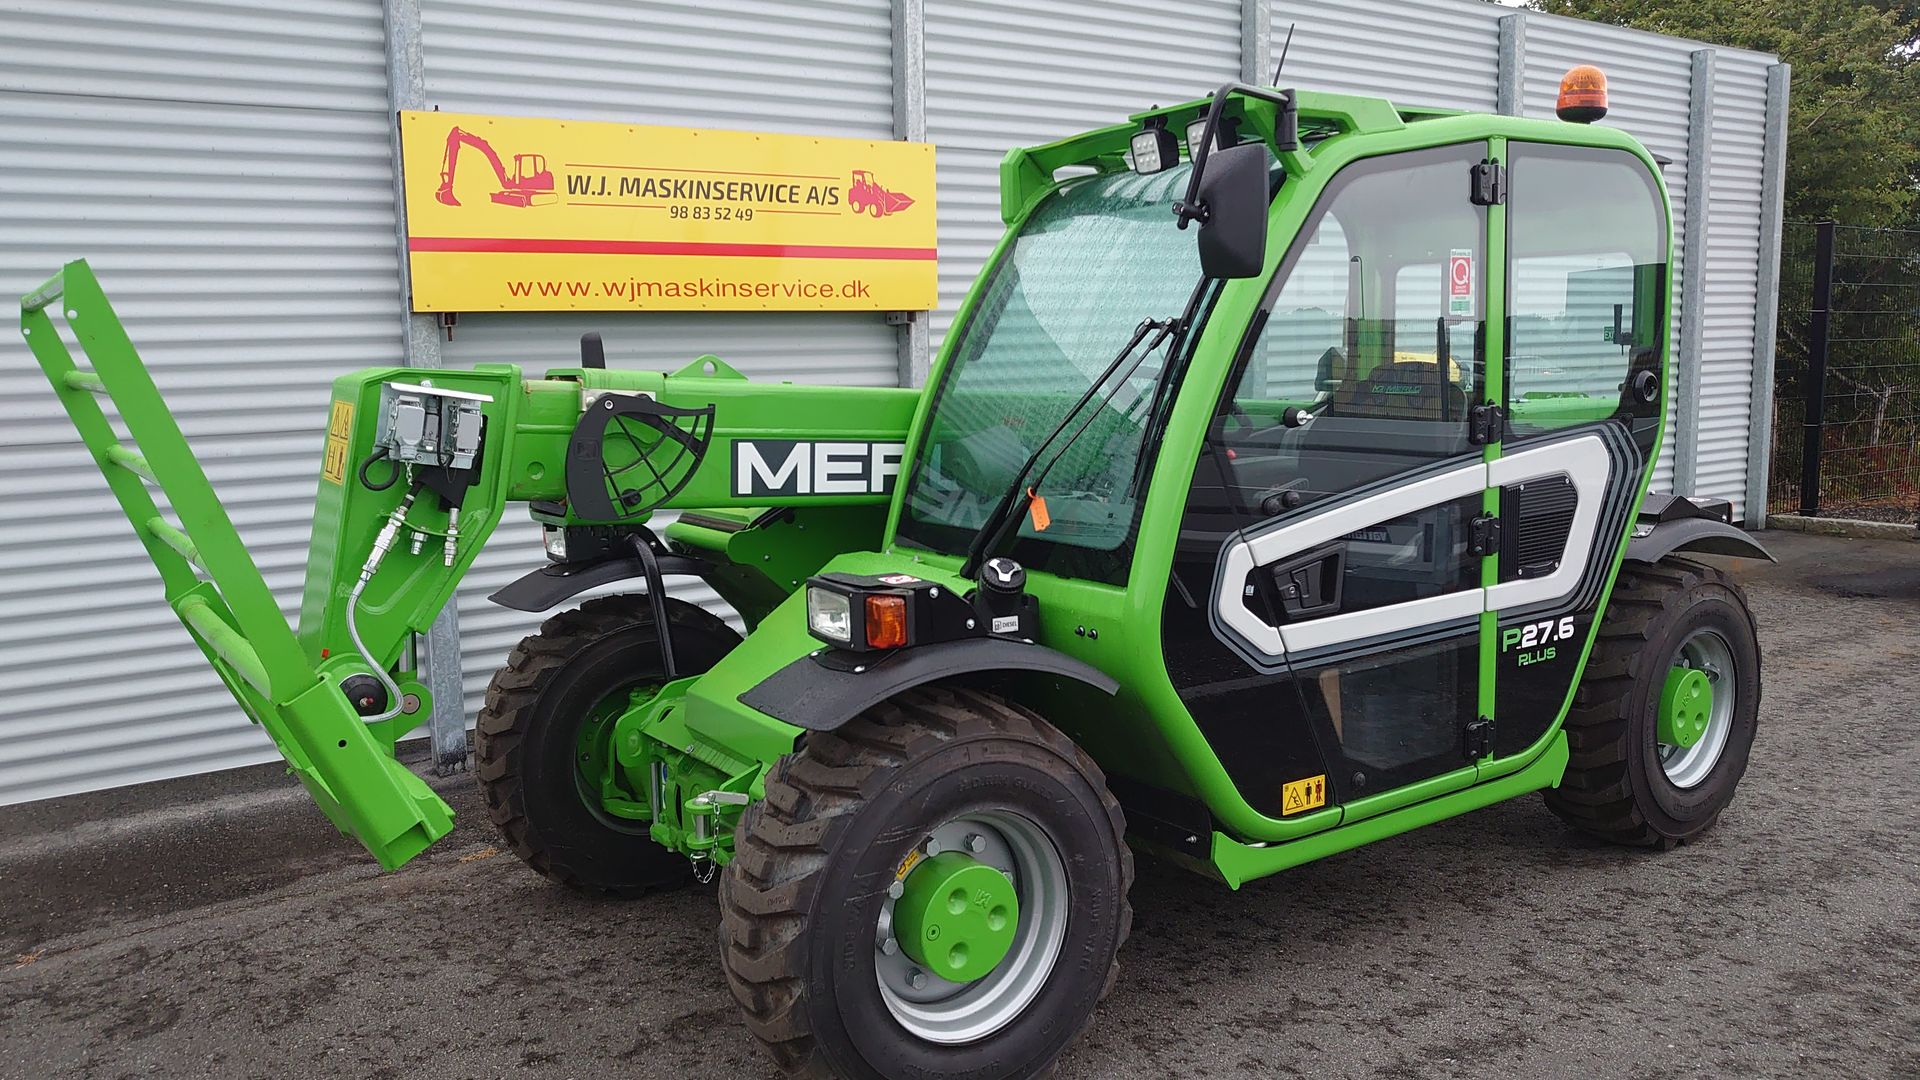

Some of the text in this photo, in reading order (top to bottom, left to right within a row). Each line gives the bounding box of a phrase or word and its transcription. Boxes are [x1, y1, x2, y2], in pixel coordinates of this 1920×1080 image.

[566, 173, 840, 206] W.J. MASKINSERVICE A/S
[669, 205, 753, 222] 98 83 52 49
[1453, 259, 1469, 285] Q
[507, 277, 871, 302] www.wjmaskinservice.dk
[1002, 620, 1018, 629] DIESEL
[1502, 616, 1575, 652] P27.6
[1518, 647, 1556, 666] PLUS
